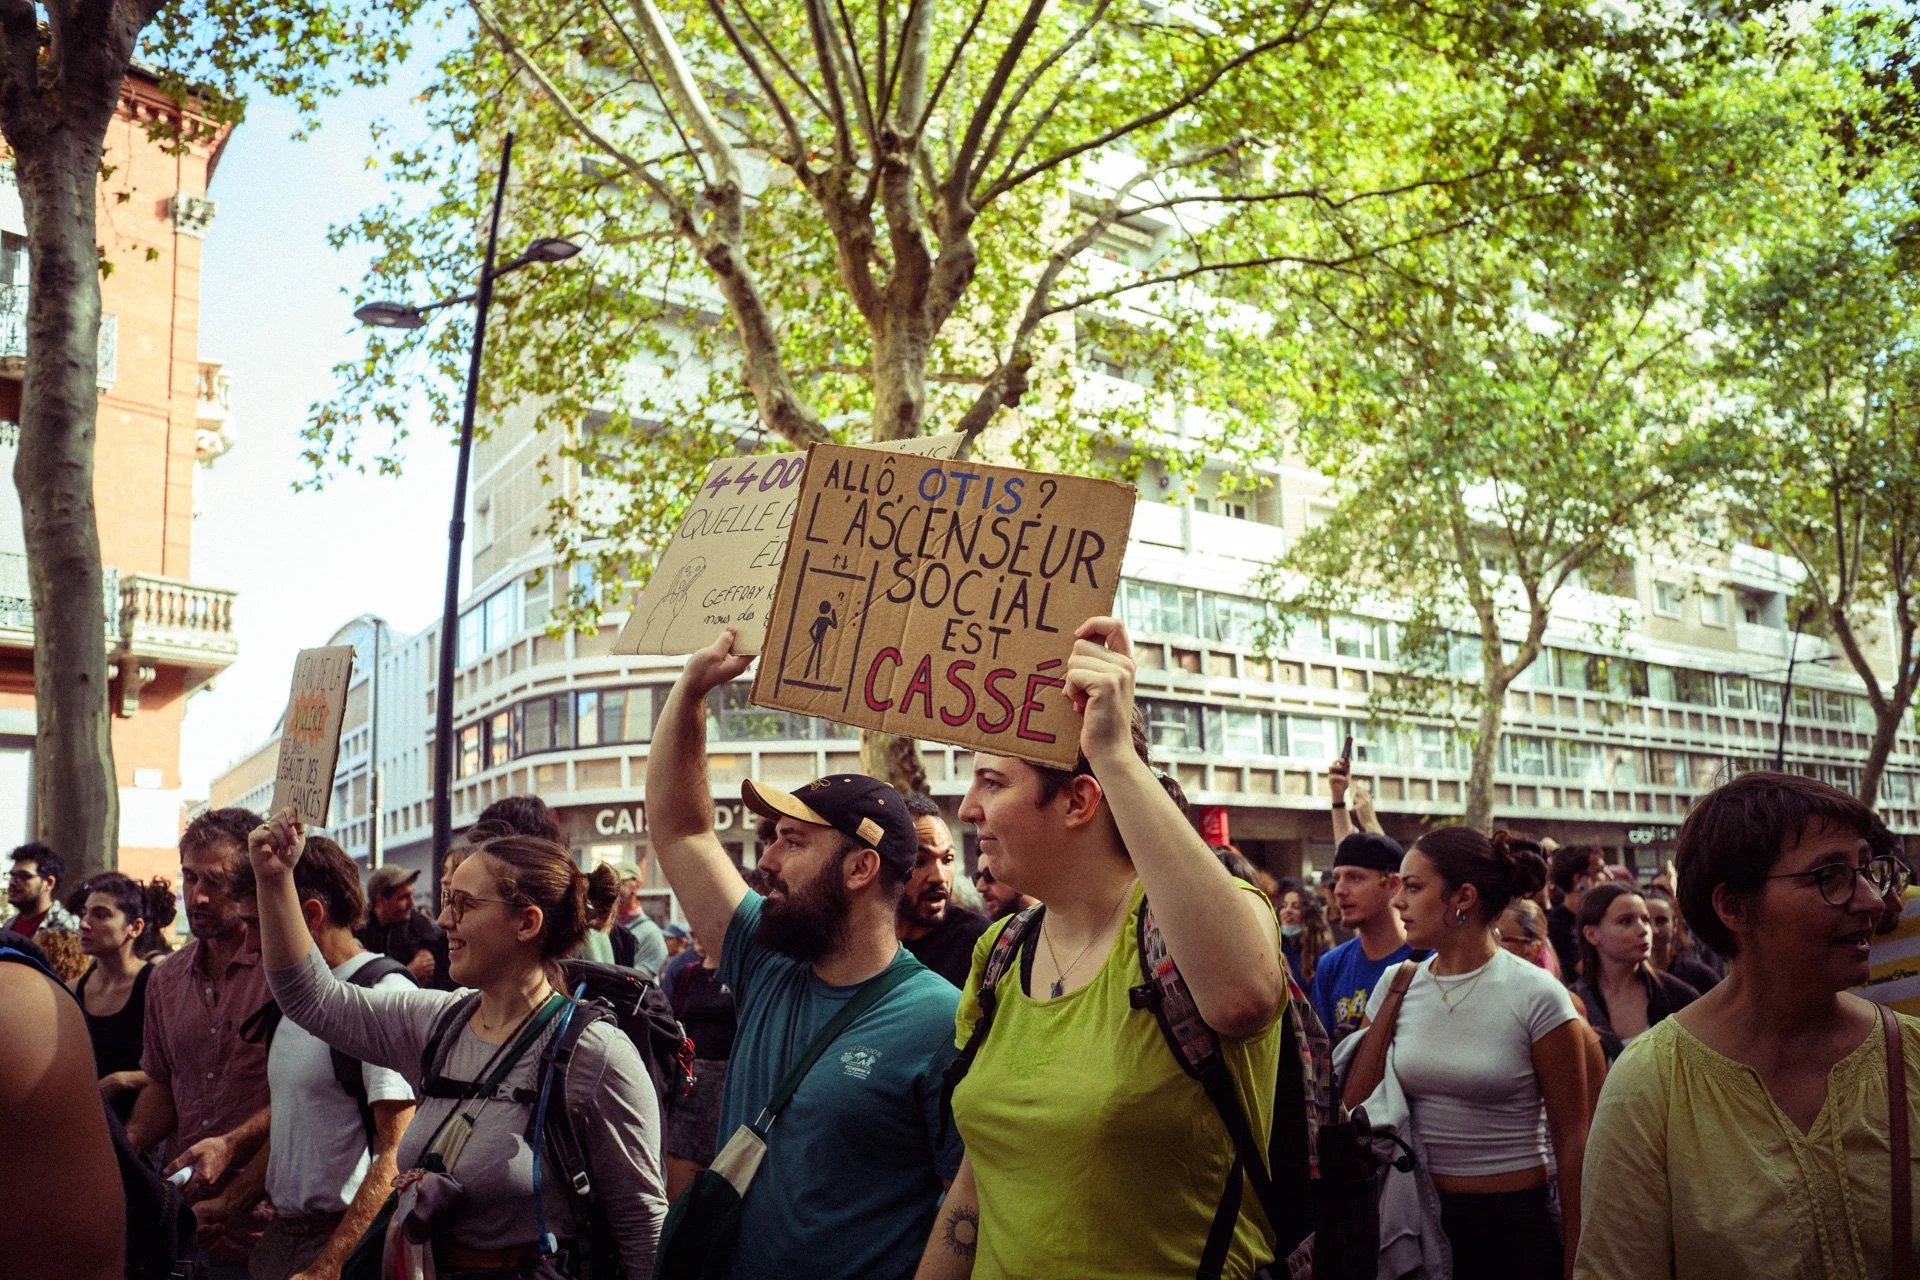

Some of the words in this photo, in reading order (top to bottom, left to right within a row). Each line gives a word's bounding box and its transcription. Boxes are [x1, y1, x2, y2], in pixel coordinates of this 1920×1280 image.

[705, 457, 805, 499] 4400
[824, 455, 904, 503] ALLÔ,
[918, 468, 1025, 515] OTIS
[1039, 480, 1058, 519] ?
[681, 501, 781, 540] QUELLE
[806, 492, 1106, 589] L'ASCENSEUR
[703, 612, 731, 626] nous
[737, 603, 755, 622] des
[942, 618, 1012, 660] EST
[329, 657, 343, 691] LA
[864, 647, 1066, 744] CASSÉ
[287, 784, 323, 820] CHANCES
[595, 807, 649, 836] CAI
